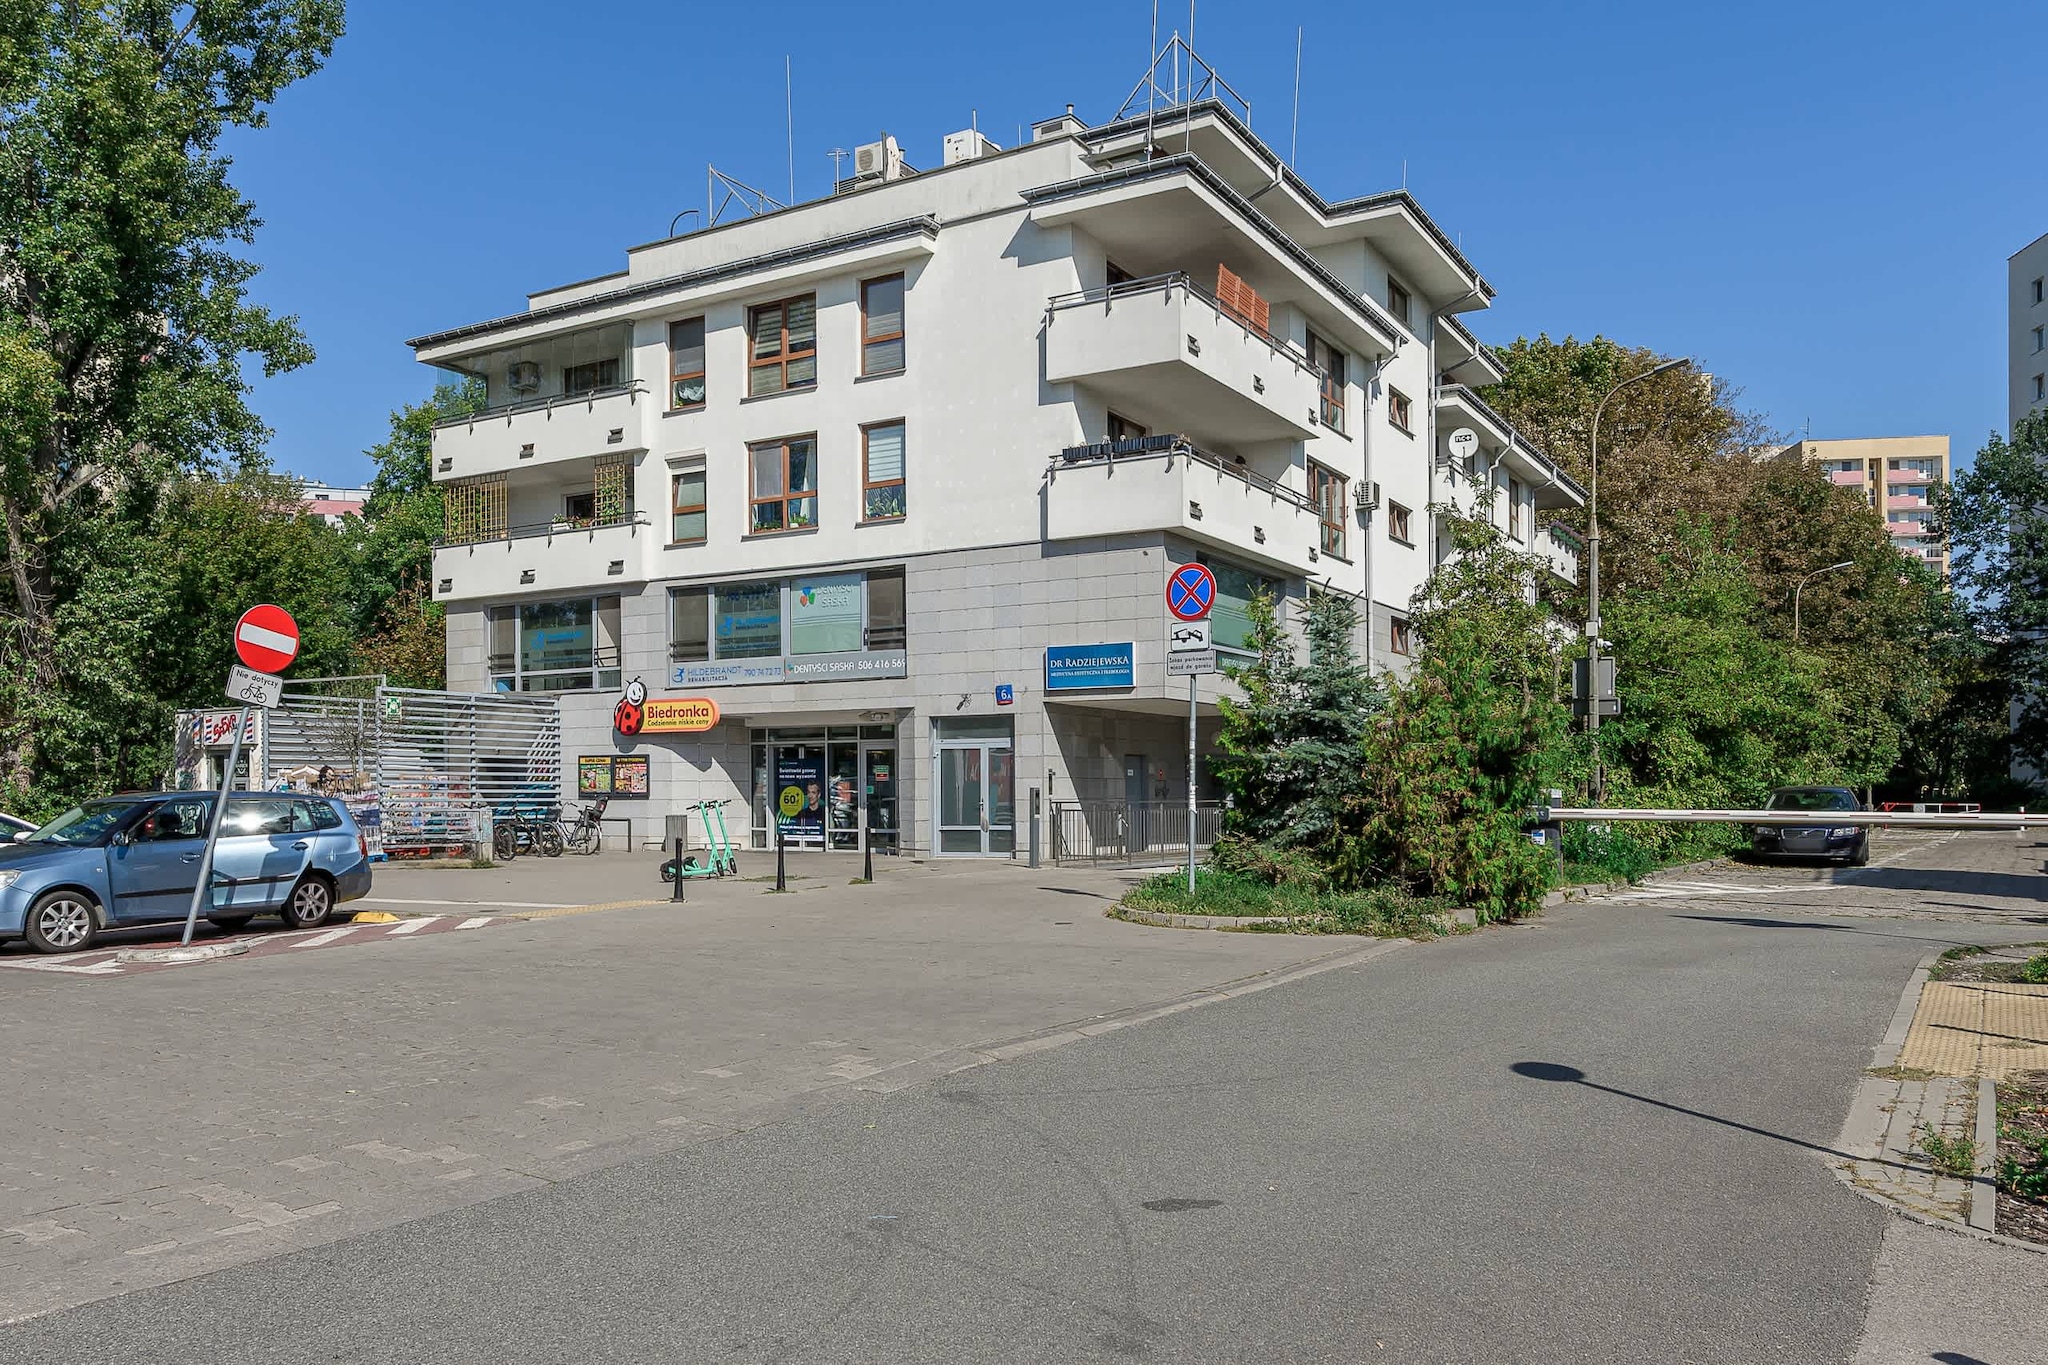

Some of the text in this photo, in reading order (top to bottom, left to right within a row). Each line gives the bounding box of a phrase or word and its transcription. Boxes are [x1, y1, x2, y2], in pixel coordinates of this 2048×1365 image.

[793, 662, 828, 674] DENTYŚCI
[829, 662, 855, 672] SASKA
[857, 660, 873, 670] 506
[874, 659, 890, 669] 416
[1050, 655, 1129, 668] DR RADZIEJEWSKA
[687, 665, 742, 676] HILDEBRANDT
[236, 669, 279, 689] Nie dotyczy
[647, 705, 709, 719] Biedronka
[695, 719, 709, 727] ceny
